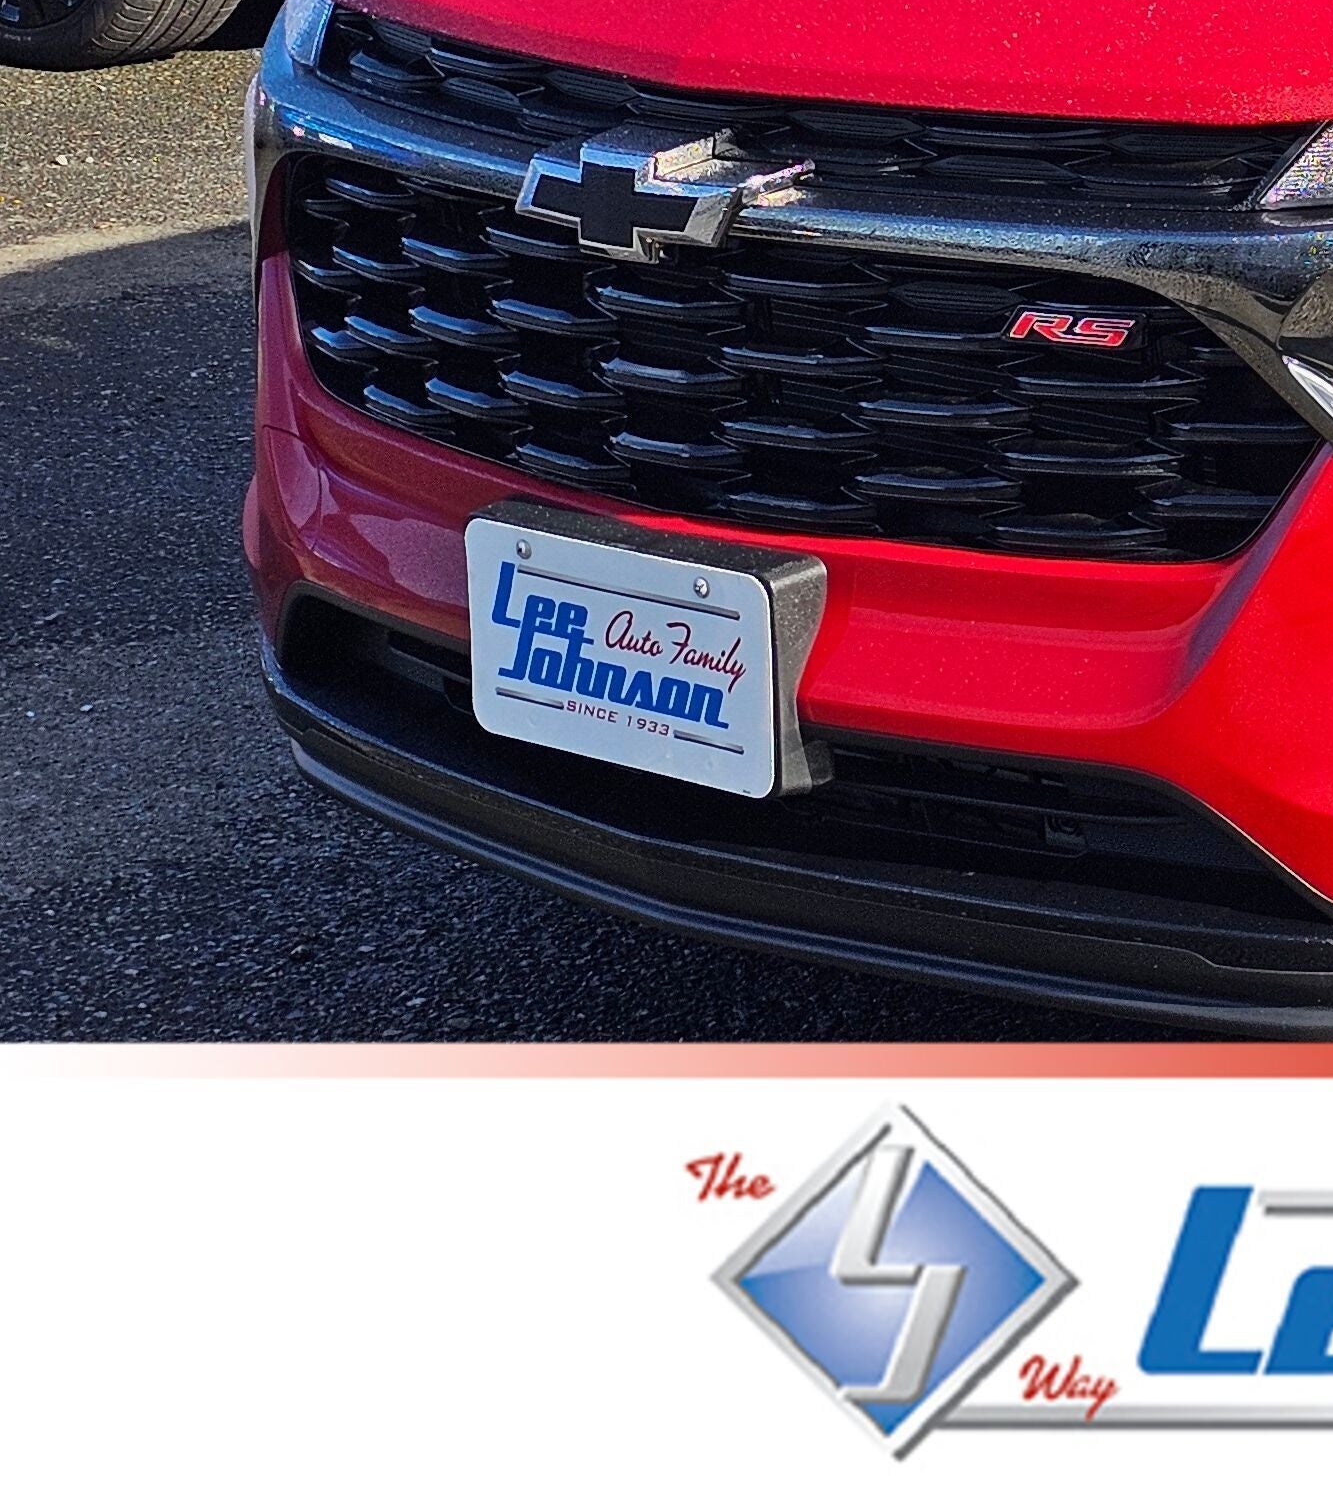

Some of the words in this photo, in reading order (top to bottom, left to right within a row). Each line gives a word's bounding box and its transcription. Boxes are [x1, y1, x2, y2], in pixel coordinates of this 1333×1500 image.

[1009, 311, 1136, 347] RS
[491, 560, 595, 645] Lee
[497, 624, 730, 730] Johnson
[605, 610, 664, 657] Auto
[666, 621, 747, 693] Family
[565, 699, 619, 724] SINCE
[625, 715, 671, 738] 1933
